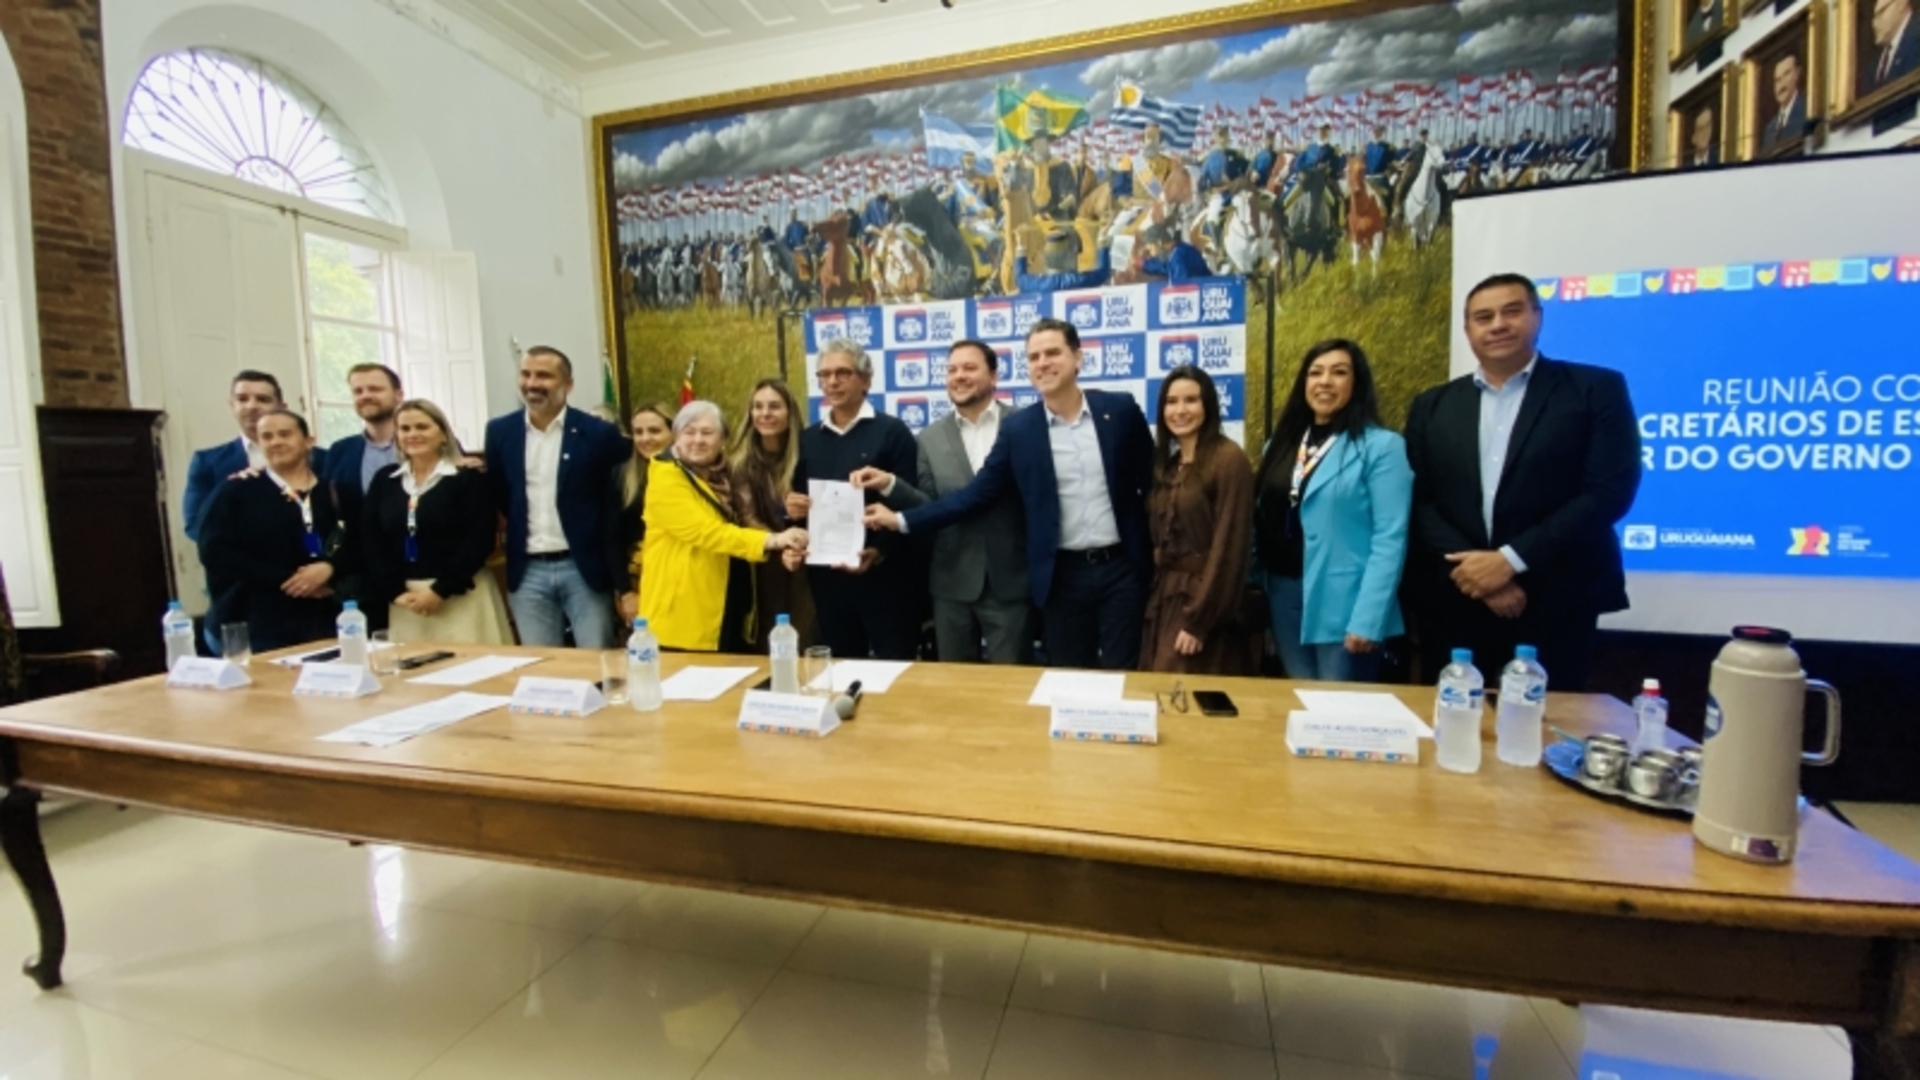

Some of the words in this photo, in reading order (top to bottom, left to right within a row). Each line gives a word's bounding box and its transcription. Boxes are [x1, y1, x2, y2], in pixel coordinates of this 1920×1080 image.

[1202, 287, 1227, 298] URU
[1202, 309, 1229, 321] ANA
[1202, 337, 1227, 347] URU
[1202, 347, 1231, 358] GUAI
[1202, 358, 1229, 368] ANA
[1703, 370, 1862, 406] REUNIÃO
[1638, 404, 1827, 439] CRETÁRIOS
[1837, 409, 1883, 436] DE
[1664, 445, 1719, 470] DO
[1728, 444, 1912, 470] GOVERNO
[1659, 532, 1755, 546] URUGUAIANA
